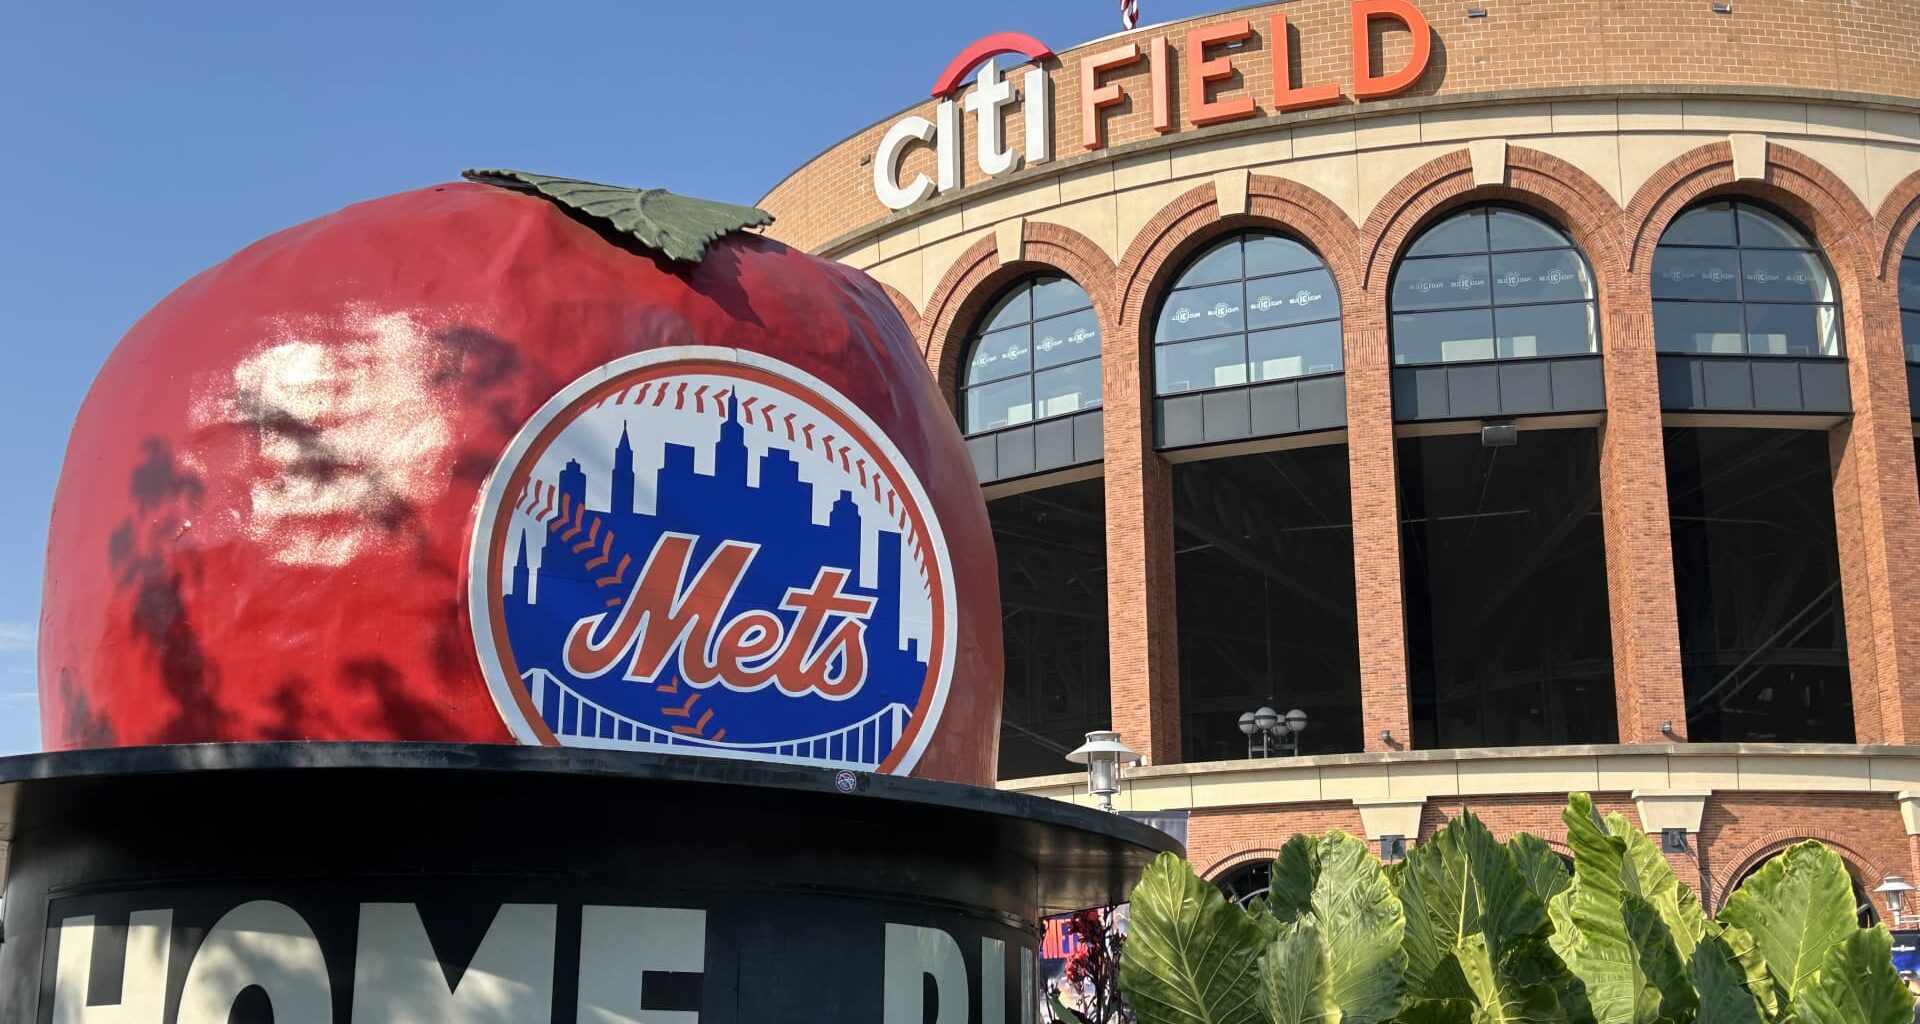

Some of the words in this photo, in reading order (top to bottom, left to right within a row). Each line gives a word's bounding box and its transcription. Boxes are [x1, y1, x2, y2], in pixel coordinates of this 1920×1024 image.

[873, 58, 1051, 210] citi
[1081, 0, 1431, 149] FIELD
[562, 531, 878, 701] Mets
